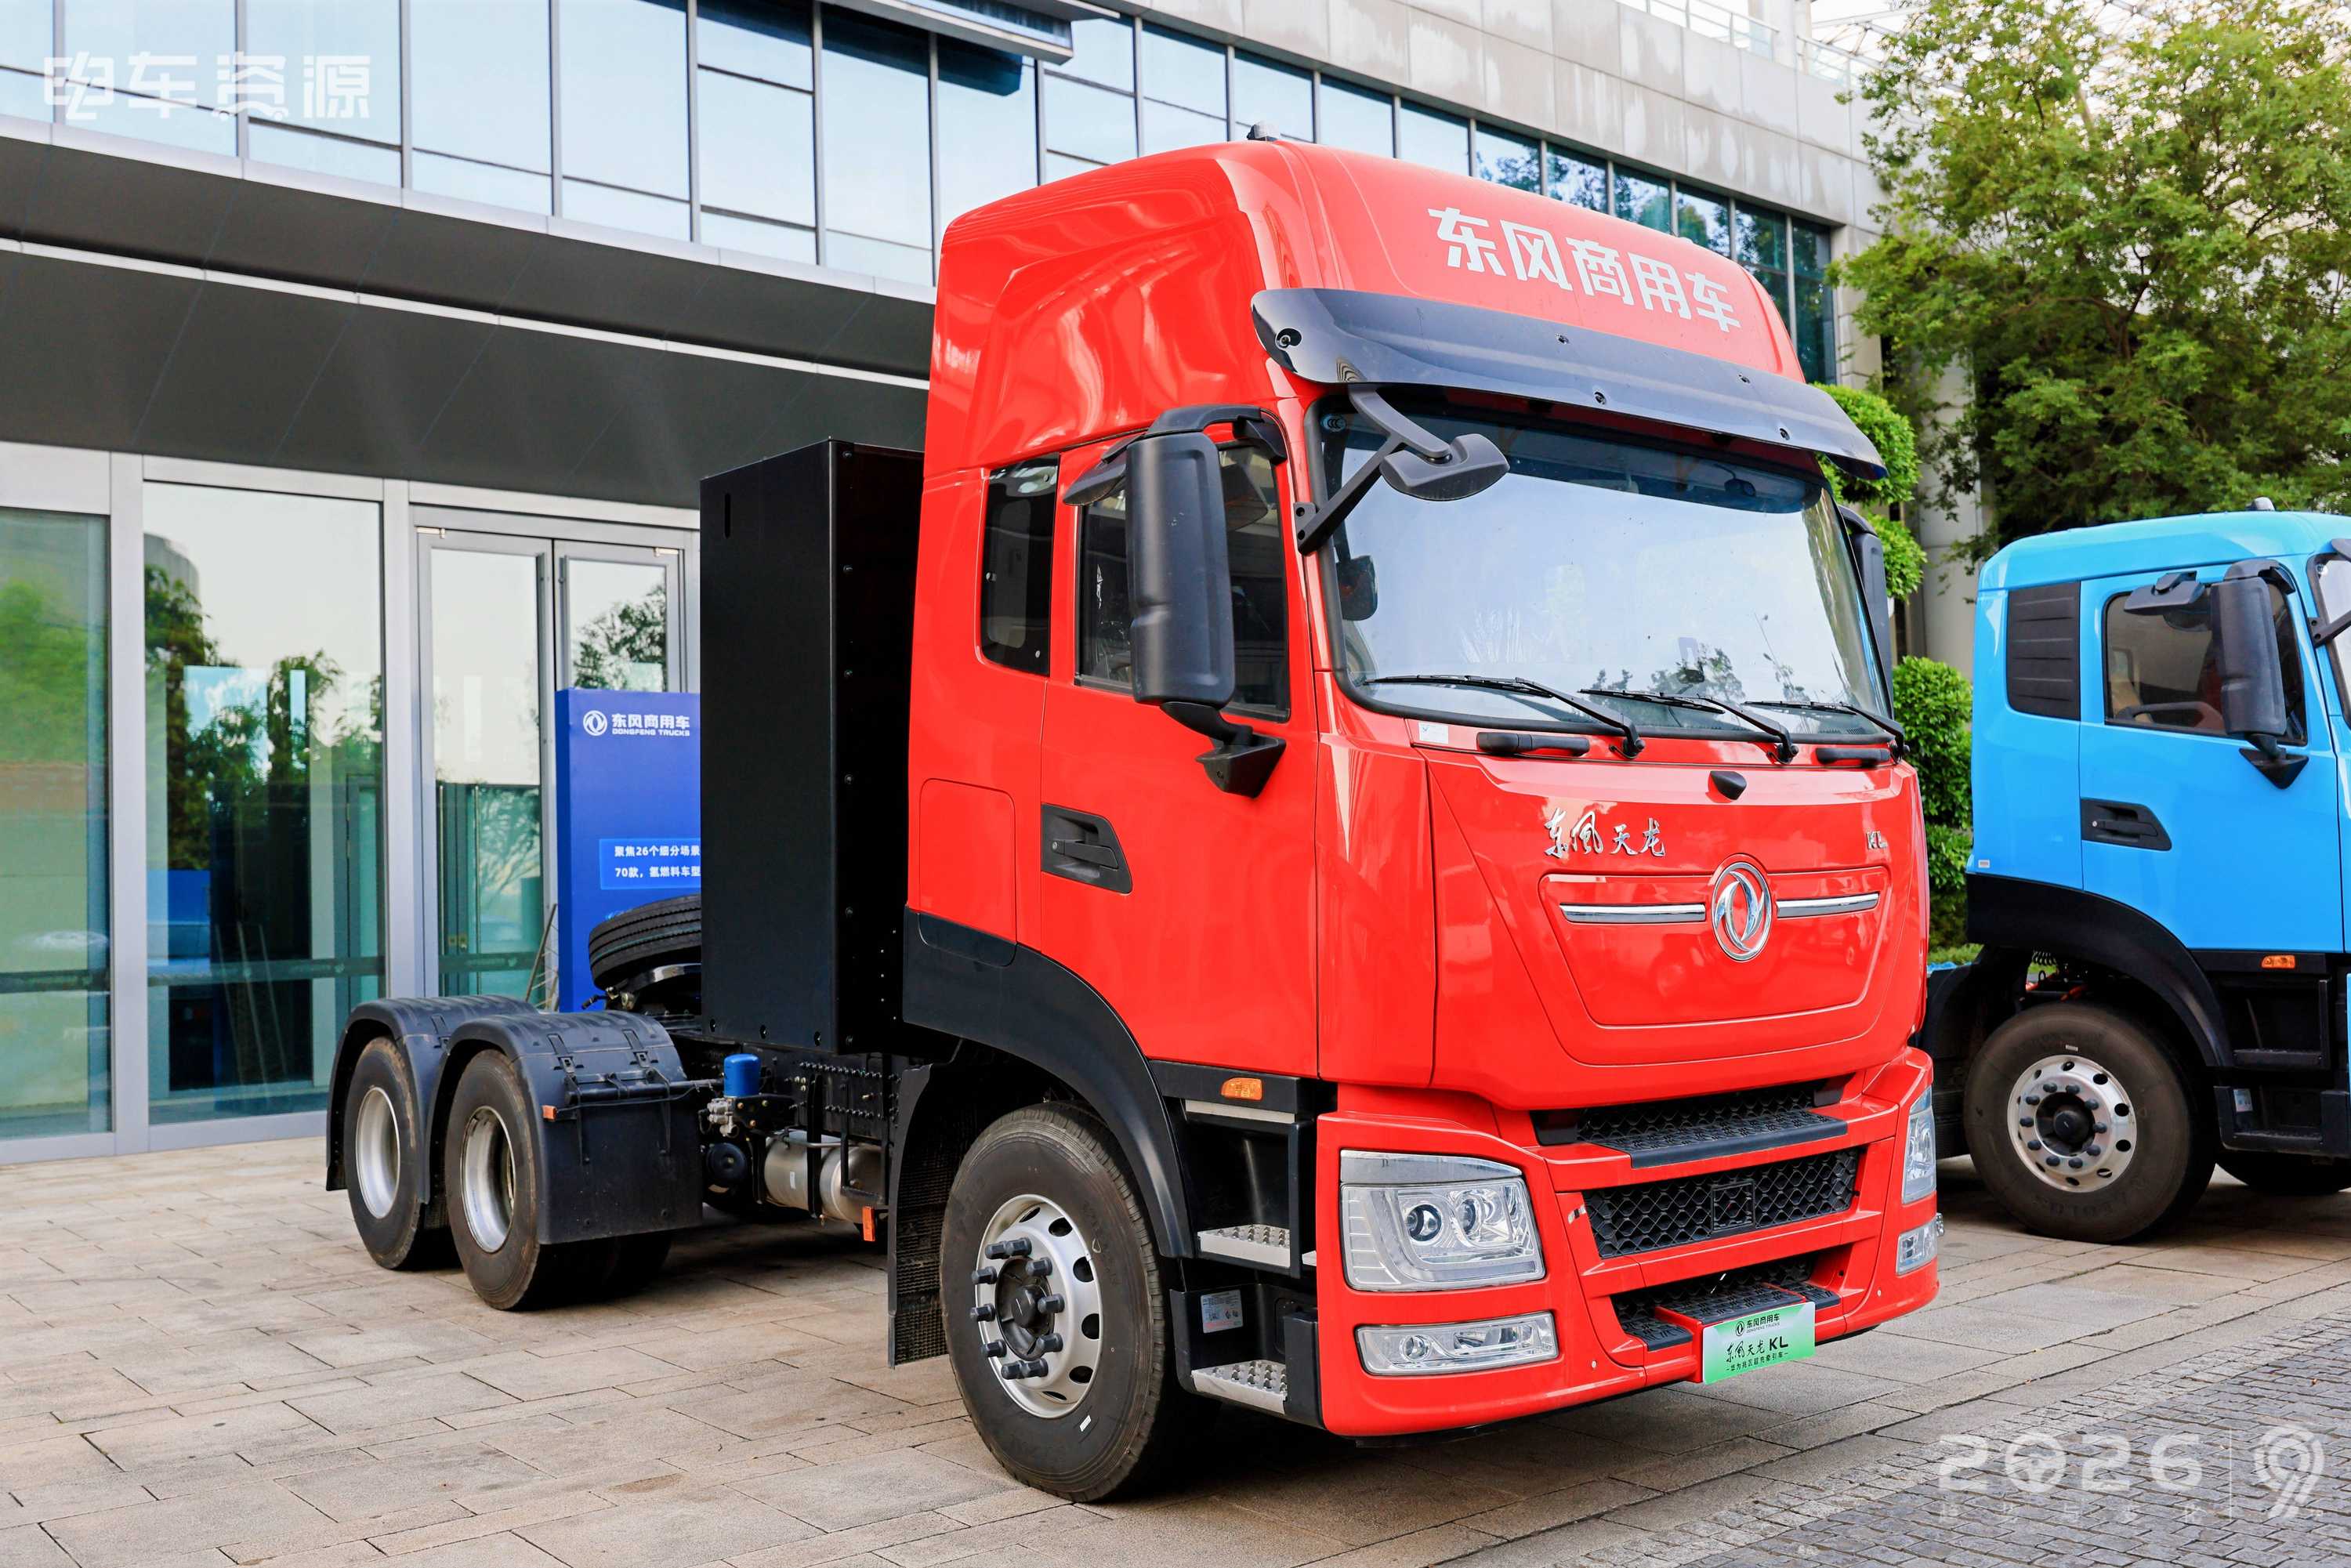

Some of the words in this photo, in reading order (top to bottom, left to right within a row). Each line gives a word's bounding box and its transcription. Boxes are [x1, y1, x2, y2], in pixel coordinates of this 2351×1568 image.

[1427, 206, 1741, 333] 东风商用车
[611, 712, 690, 730] 东风商用车
[611, 727, 657, 736] DONGFENG
[658, 729, 690, 737] TRUCKS
[1867, 831, 1887, 850] KL
[614, 844, 701, 858] 聚焦26个细分场景
[1746, 1313, 1780, 1329] 东风商用车
[1769, 1335, 1789, 1352] KL
